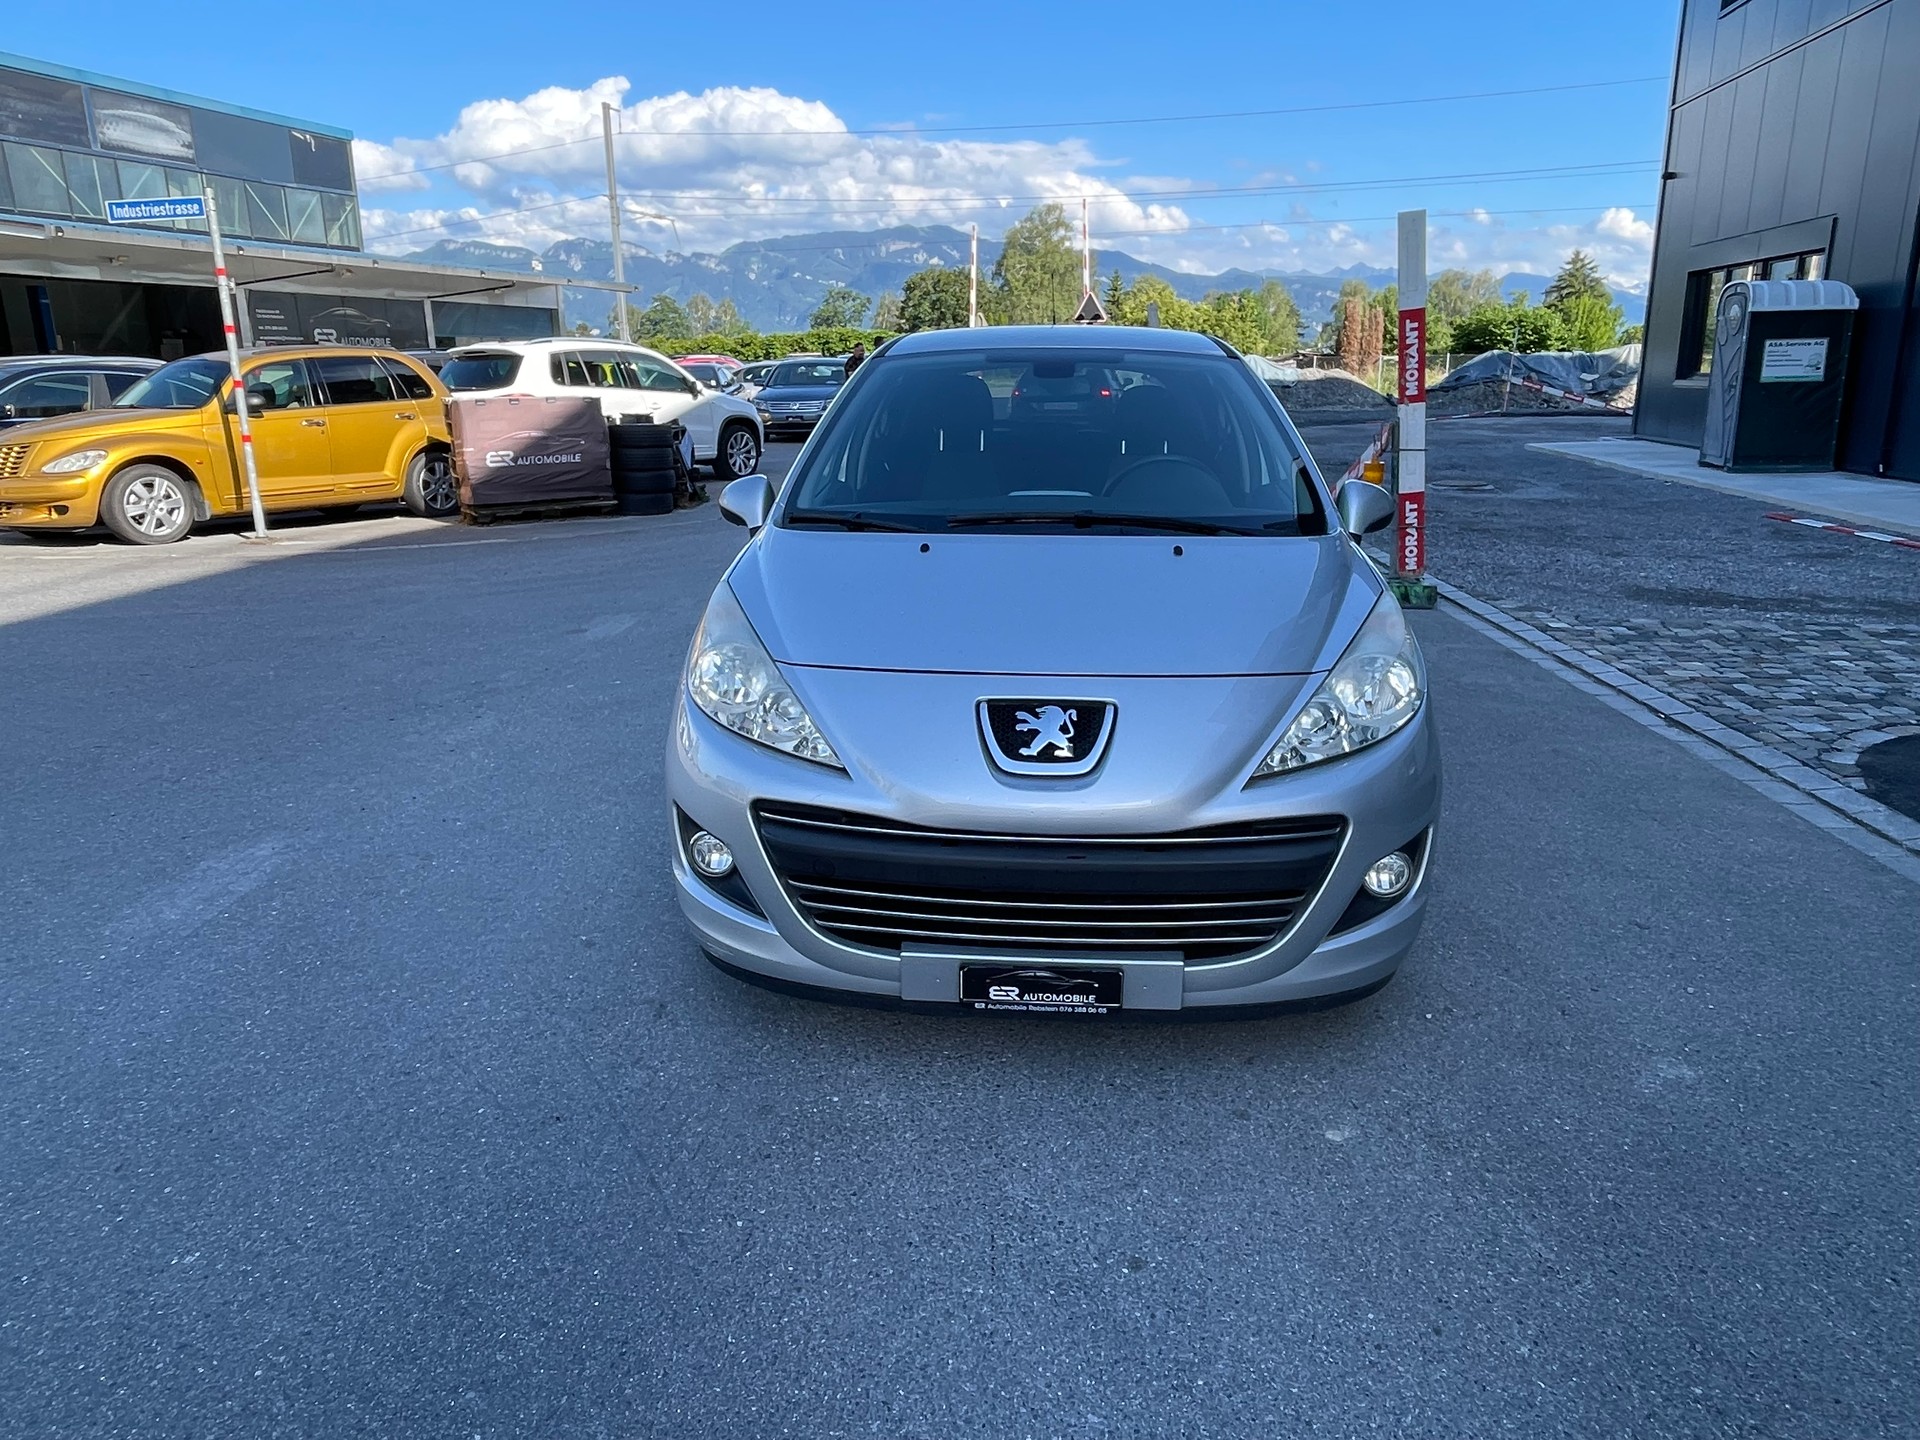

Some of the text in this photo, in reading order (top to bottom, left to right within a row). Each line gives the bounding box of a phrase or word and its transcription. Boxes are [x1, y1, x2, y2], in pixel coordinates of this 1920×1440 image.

[111, 202, 201, 219] Industriestrasse
[341, 336, 392, 347] AUTOMOBILE
[1404, 319, 1419, 396] MORANT
[516, 453, 582, 465] AUTOMOBILE
[1404, 500, 1419, 571] MORANT
[1022, 993, 1097, 1004] AUTOMOBILE
[987, 1003, 1028, 1011] Automobile
[1028, 1004, 1058, 1012] Rebstein
